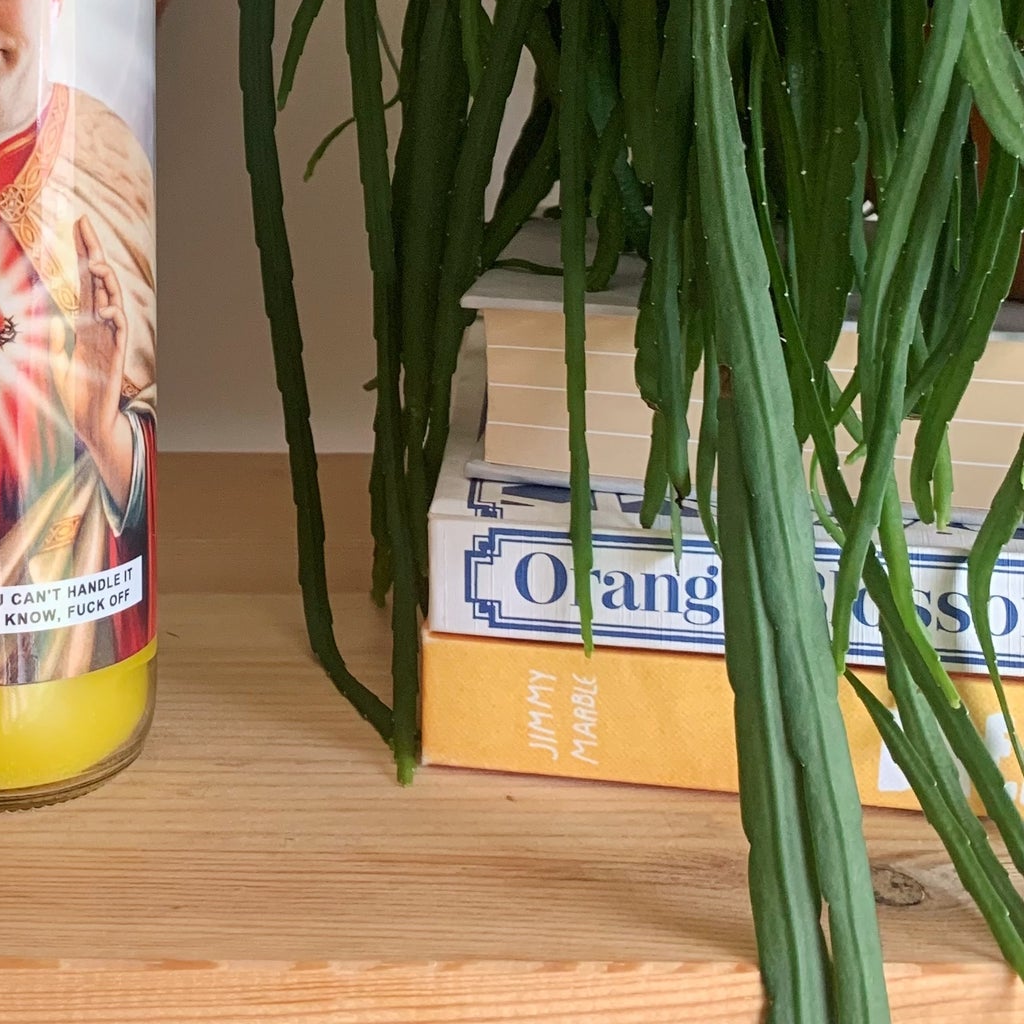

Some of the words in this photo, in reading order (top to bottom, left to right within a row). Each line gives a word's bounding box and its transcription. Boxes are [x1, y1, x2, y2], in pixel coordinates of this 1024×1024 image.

[5, 608, 61, 626] KNOW,
[67, 598, 105, 619] FUCK
[109, 588, 130, 606] OFF
[11, 588, 62, 605] CAN'T
[67, 573, 121, 598] HANDLE
[124, 567, 133, 582] IT
[526, 669, 558, 760] JIMMY
[570, 673, 599, 765] MARBLE
